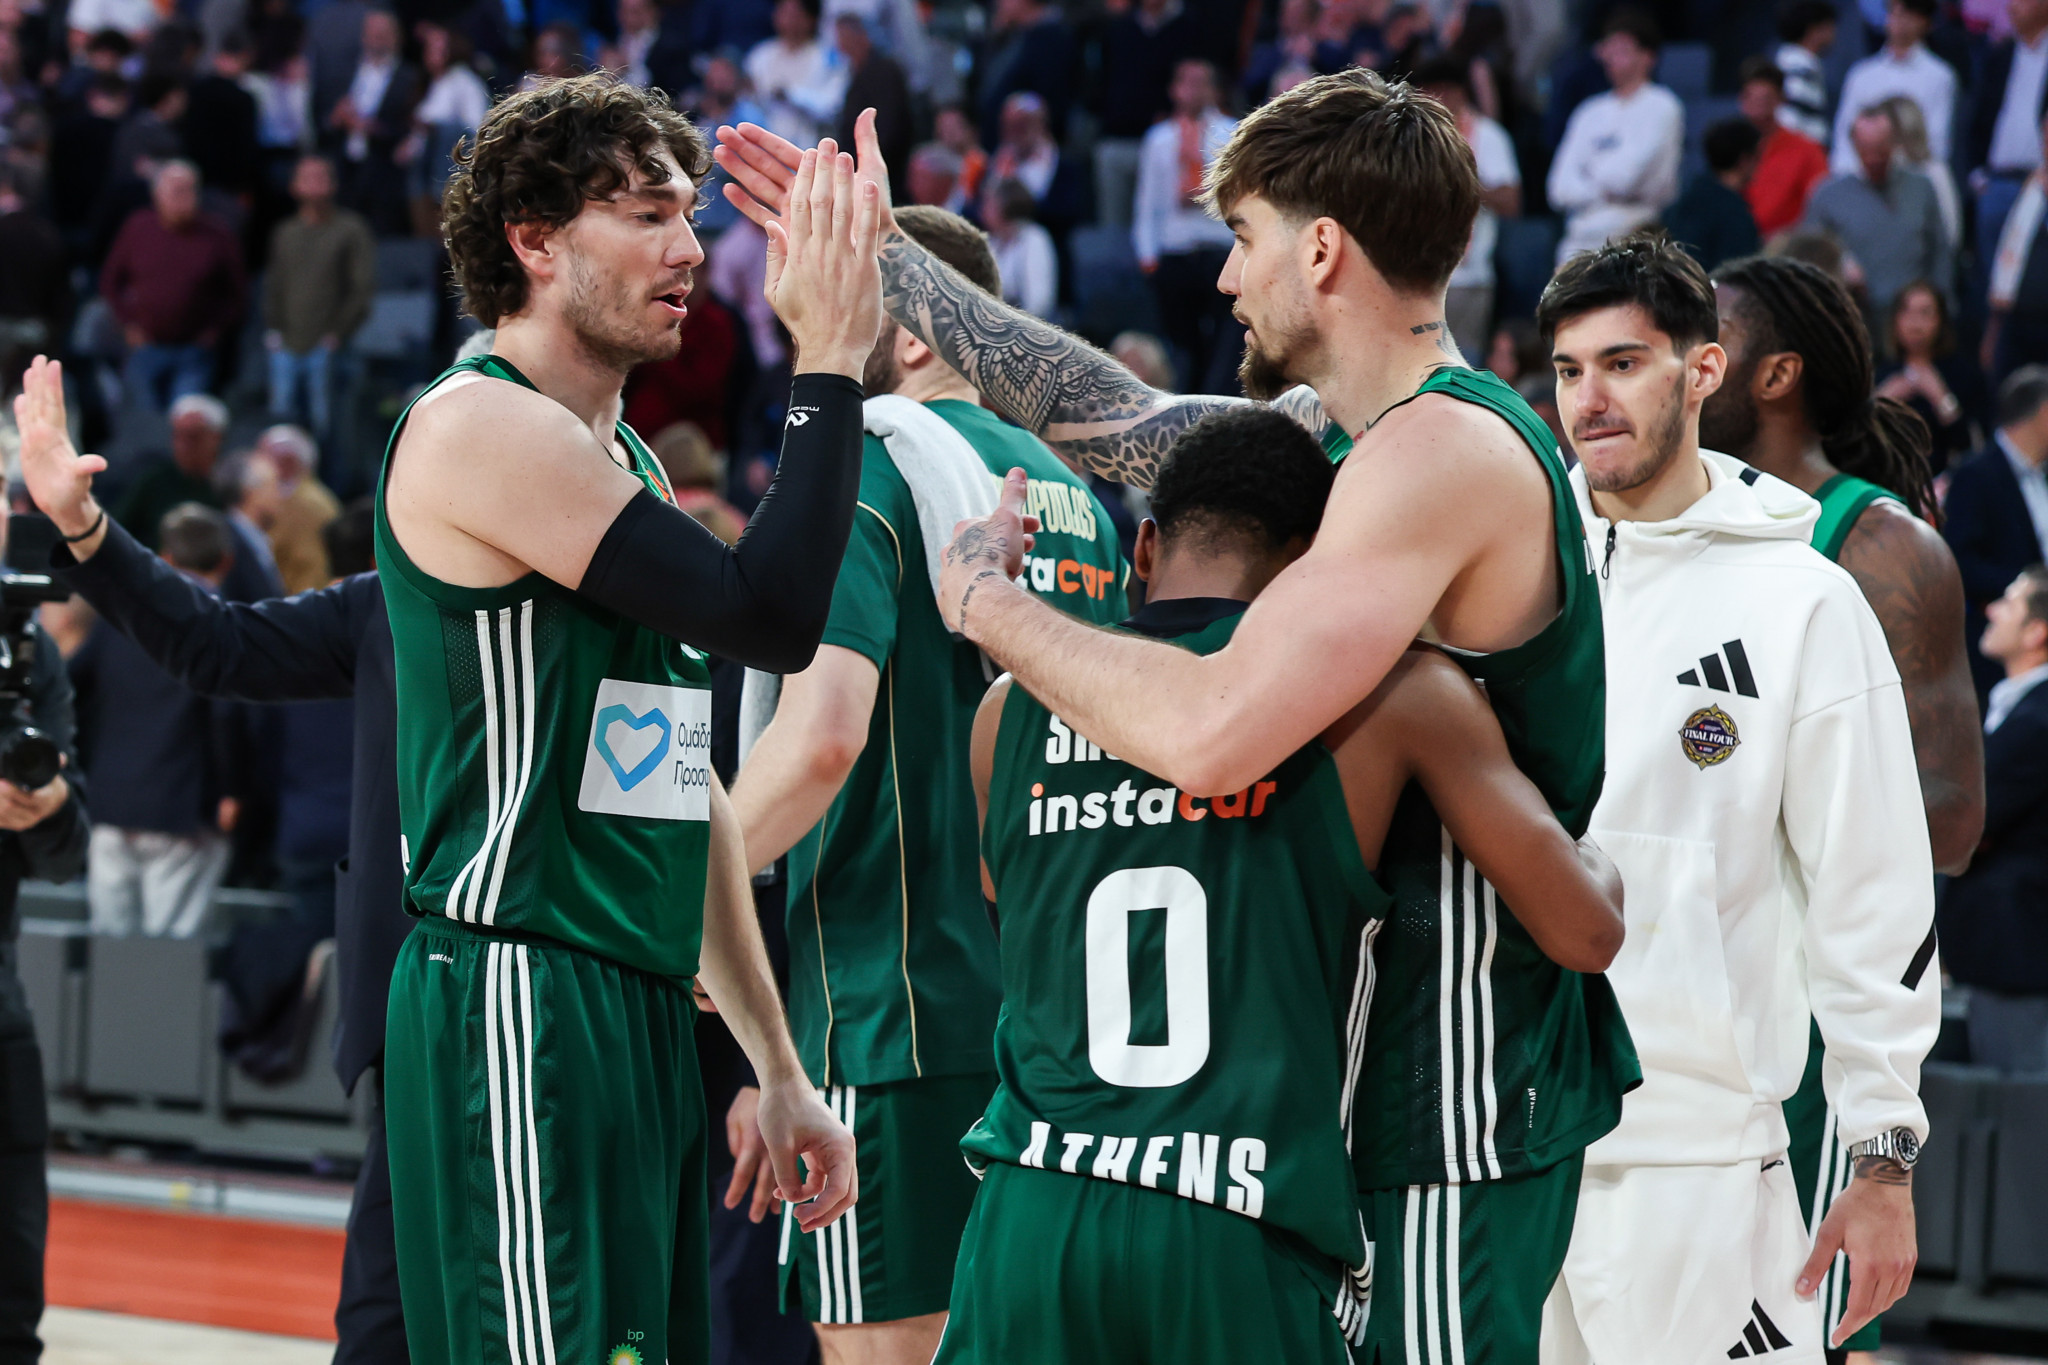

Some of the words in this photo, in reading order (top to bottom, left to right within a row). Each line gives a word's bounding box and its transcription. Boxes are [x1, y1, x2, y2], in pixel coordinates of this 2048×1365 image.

[1684, 728, 1708, 742] FINAL
[1708, 732, 1735, 746] FOUR
[1028, 779, 1277, 836] instacar
[1085, 865, 1210, 1088] 0
[1019, 1120, 1267, 1220] ATHENS
[627, 1328, 645, 1342] bp
